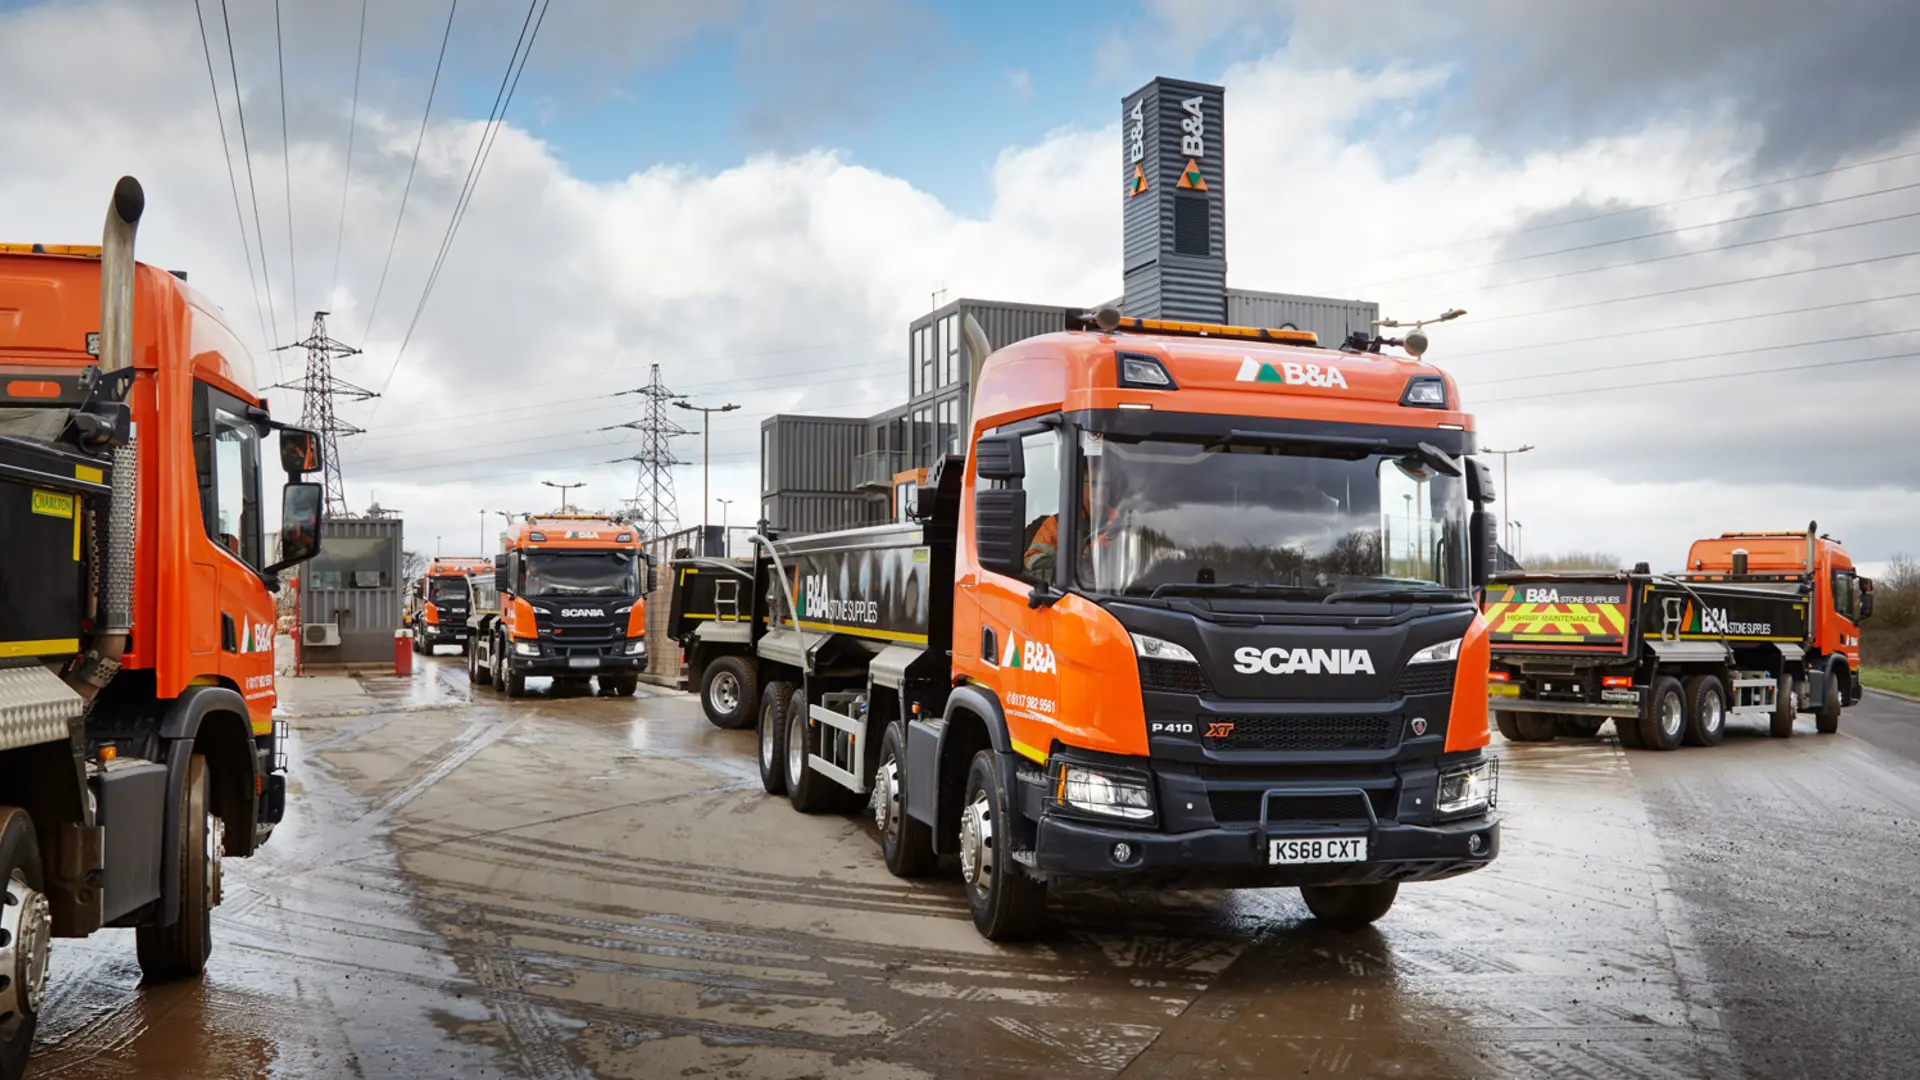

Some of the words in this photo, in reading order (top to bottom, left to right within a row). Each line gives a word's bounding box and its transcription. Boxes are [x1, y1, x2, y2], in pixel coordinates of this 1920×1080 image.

[1131, 98, 1144, 163] B&A
[1182, 96, 1204, 157] B&A
[1282, 362, 1349, 389] B&A
[806, 574, 829, 619] B&A
[829, 599, 847, 620] STONE
[848, 600, 877, 623] SUPPLIES
[1526, 588, 1559, 603] B&A
[561, 608, 605, 617] SCANIA
[1540, 613, 1597, 622] MAINTENANCE
[1702, 607, 1728, 633] B&A
[1728, 622, 1746, 634] STONE
[1746, 622, 1772, 635] SUPPLIES
[254, 623, 273, 653] B&A
[1023, 640, 1057, 675] B&A
[1233, 646, 1376, 675] SCANIA
[1152, 723, 1163, 732] P
[1164, 723, 1193, 733] 410
[1204, 722, 1234, 737] XT
[1276, 841, 1322, 860] KS68
[1327, 840, 1360, 858] CXT
